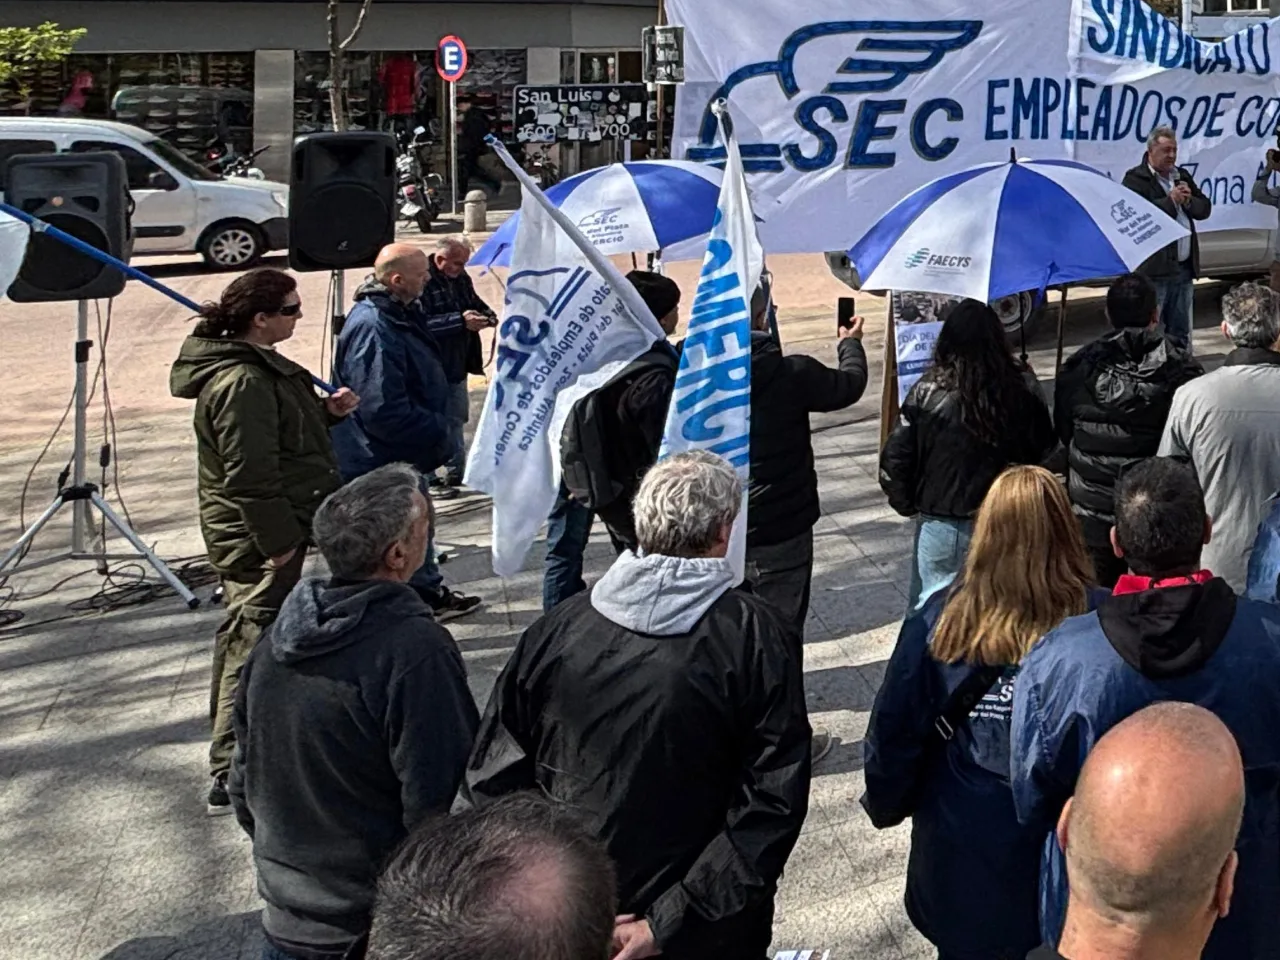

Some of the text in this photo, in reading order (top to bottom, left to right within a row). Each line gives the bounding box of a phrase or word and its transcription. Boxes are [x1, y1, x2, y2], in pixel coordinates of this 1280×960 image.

[445, 46, 459, 70] E
[518, 88, 592, 104] San Luis
[985, 77, 1186, 143] EMPLEADOS
[1182, 91, 1237, 140] DE
[781, 95, 964, 173] SEC
[593, 214, 618, 225] SEC
[592, 235, 624, 246] ERCIO
[927, 254, 972, 268] FAECYS
[914, 342, 927, 352] DE
